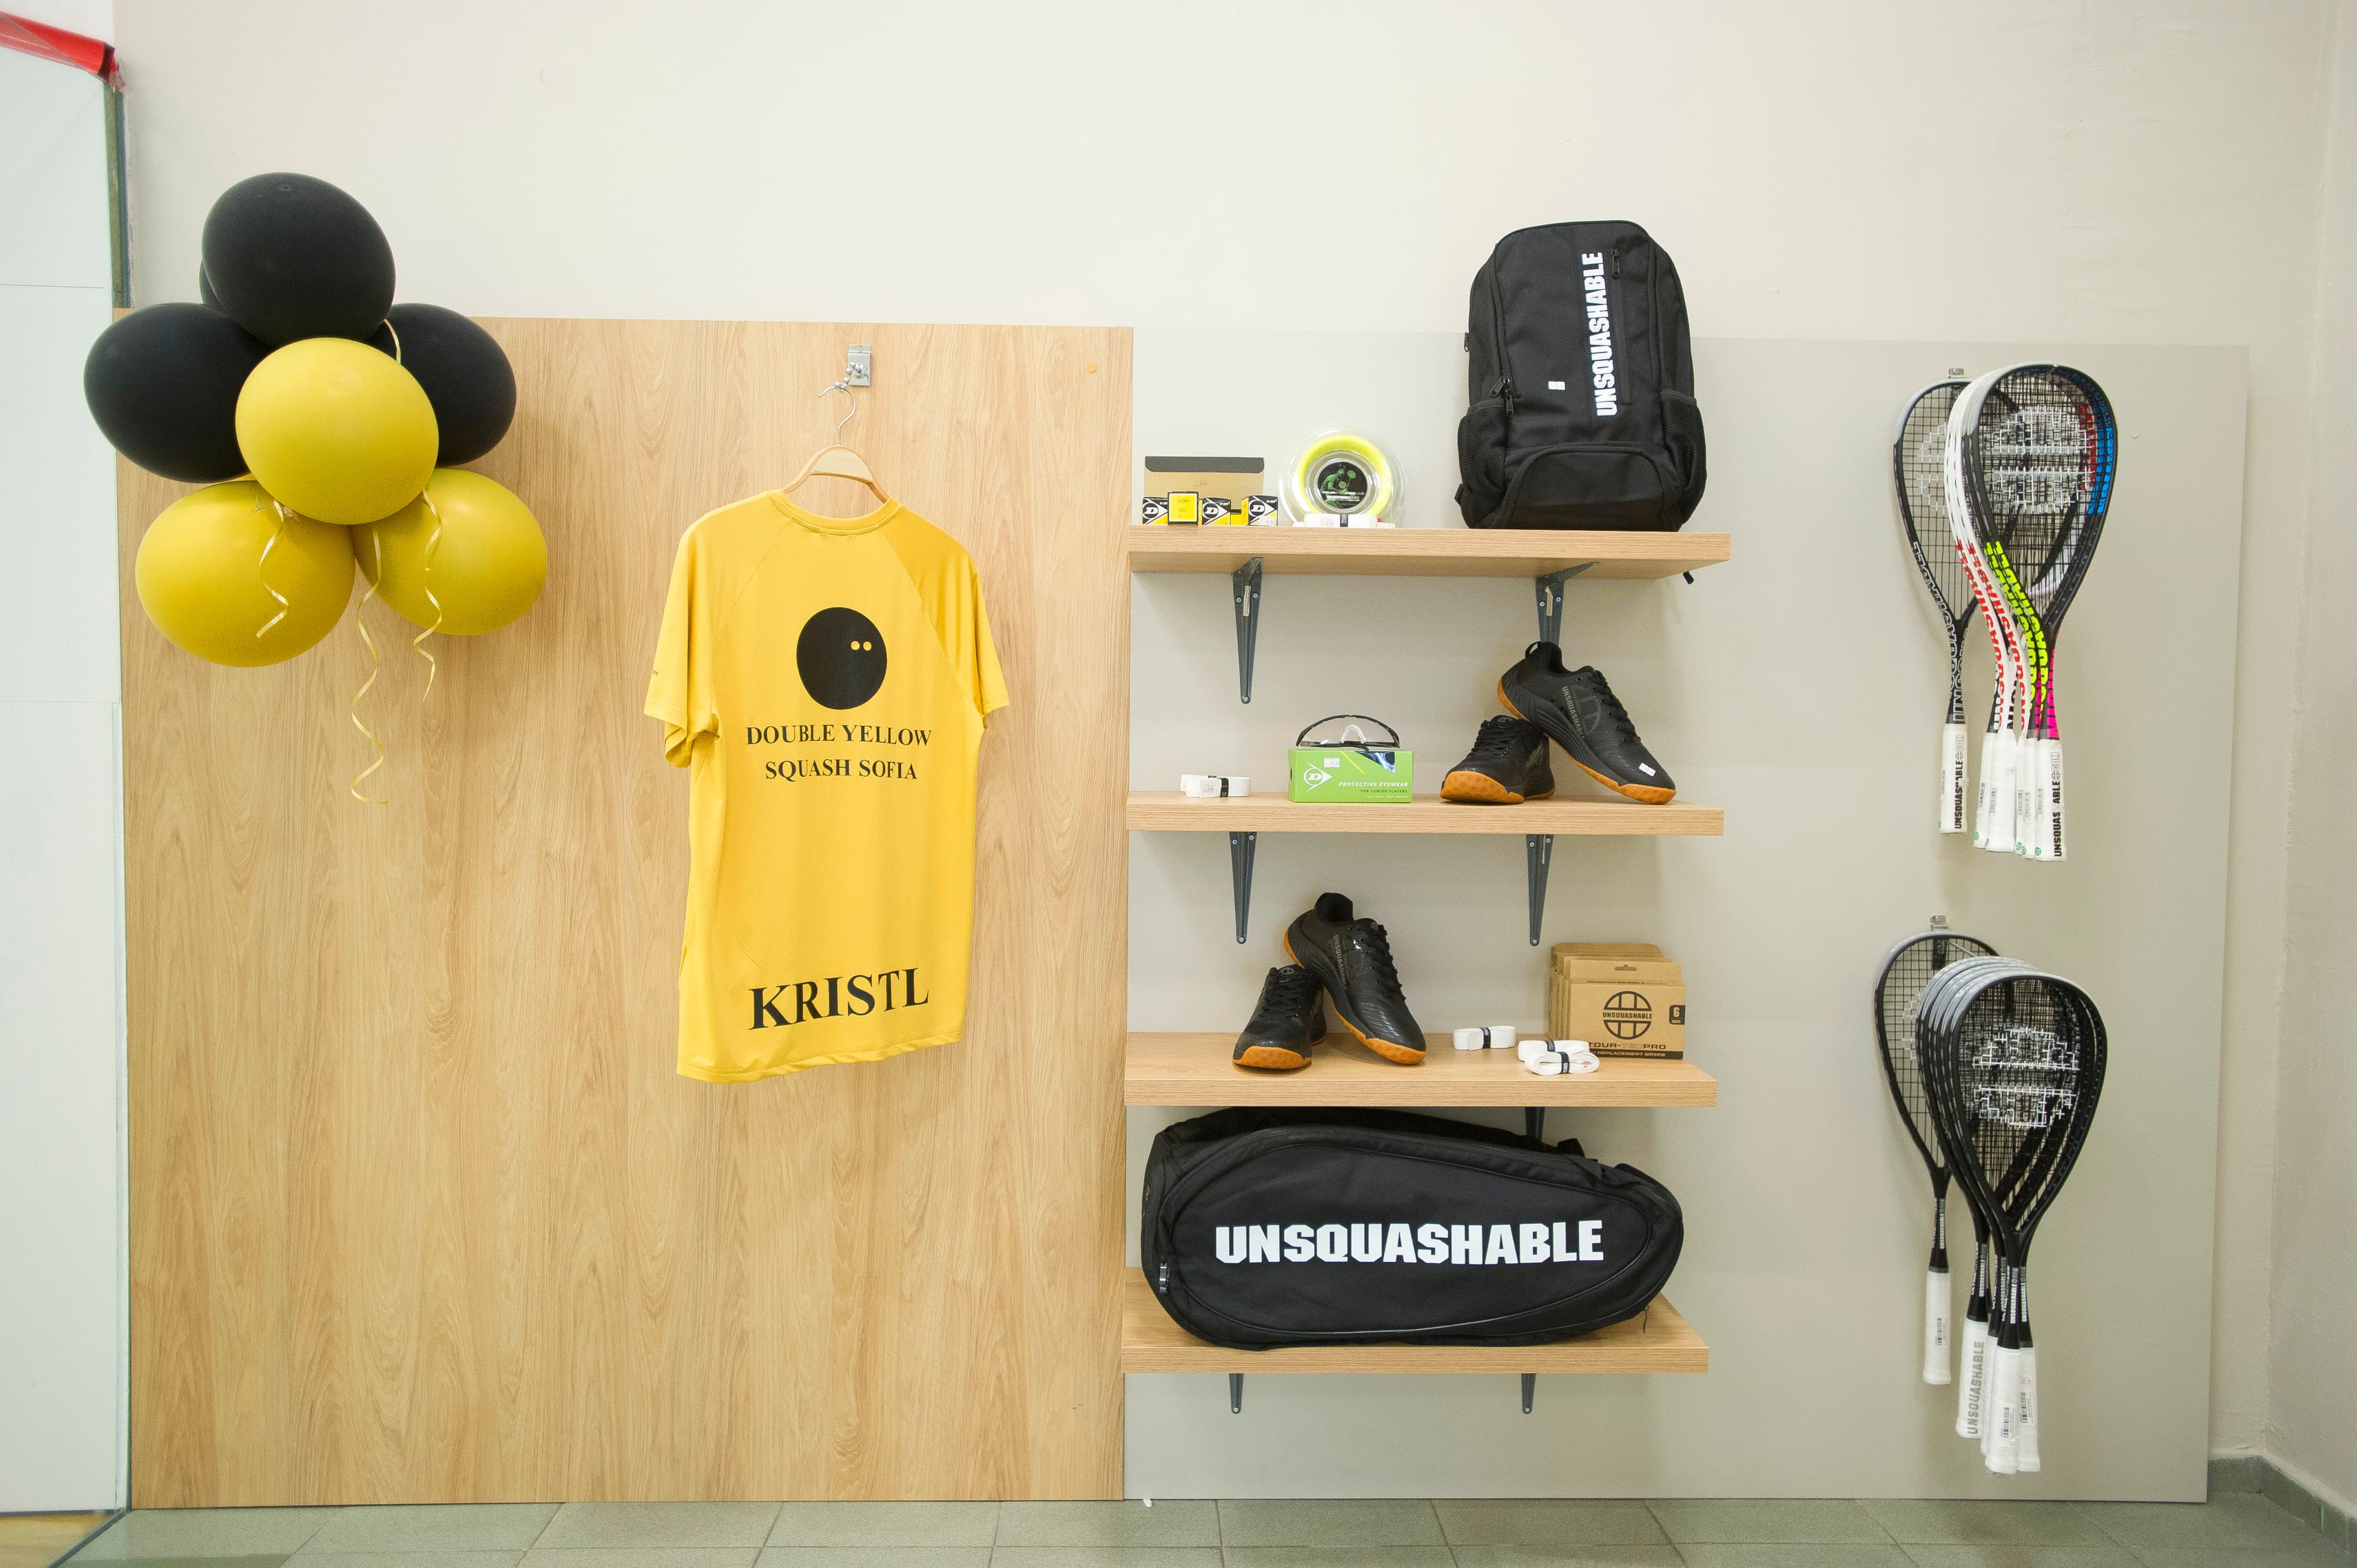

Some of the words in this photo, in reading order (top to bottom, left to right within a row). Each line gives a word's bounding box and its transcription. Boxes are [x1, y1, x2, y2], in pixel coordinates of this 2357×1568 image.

[1581, 252, 1617, 417] UNSQUASHABLE
[746, 724, 835, 745] DOUBLE
[841, 725, 932, 747] YELLOW
[765, 759, 852, 782] SQUASH
[859, 760, 918, 780] SOFIA
[2051, 780, 2062, 857] UNSQUASABLE
[748, 967, 929, 1030] KRISTL
[1673, 1006, 1680, 1018] 6
[1215, 1219, 1604, 1265] UNSQUASHABLE
[1967, 1342, 1985, 1435] UNSQUASHABLE
